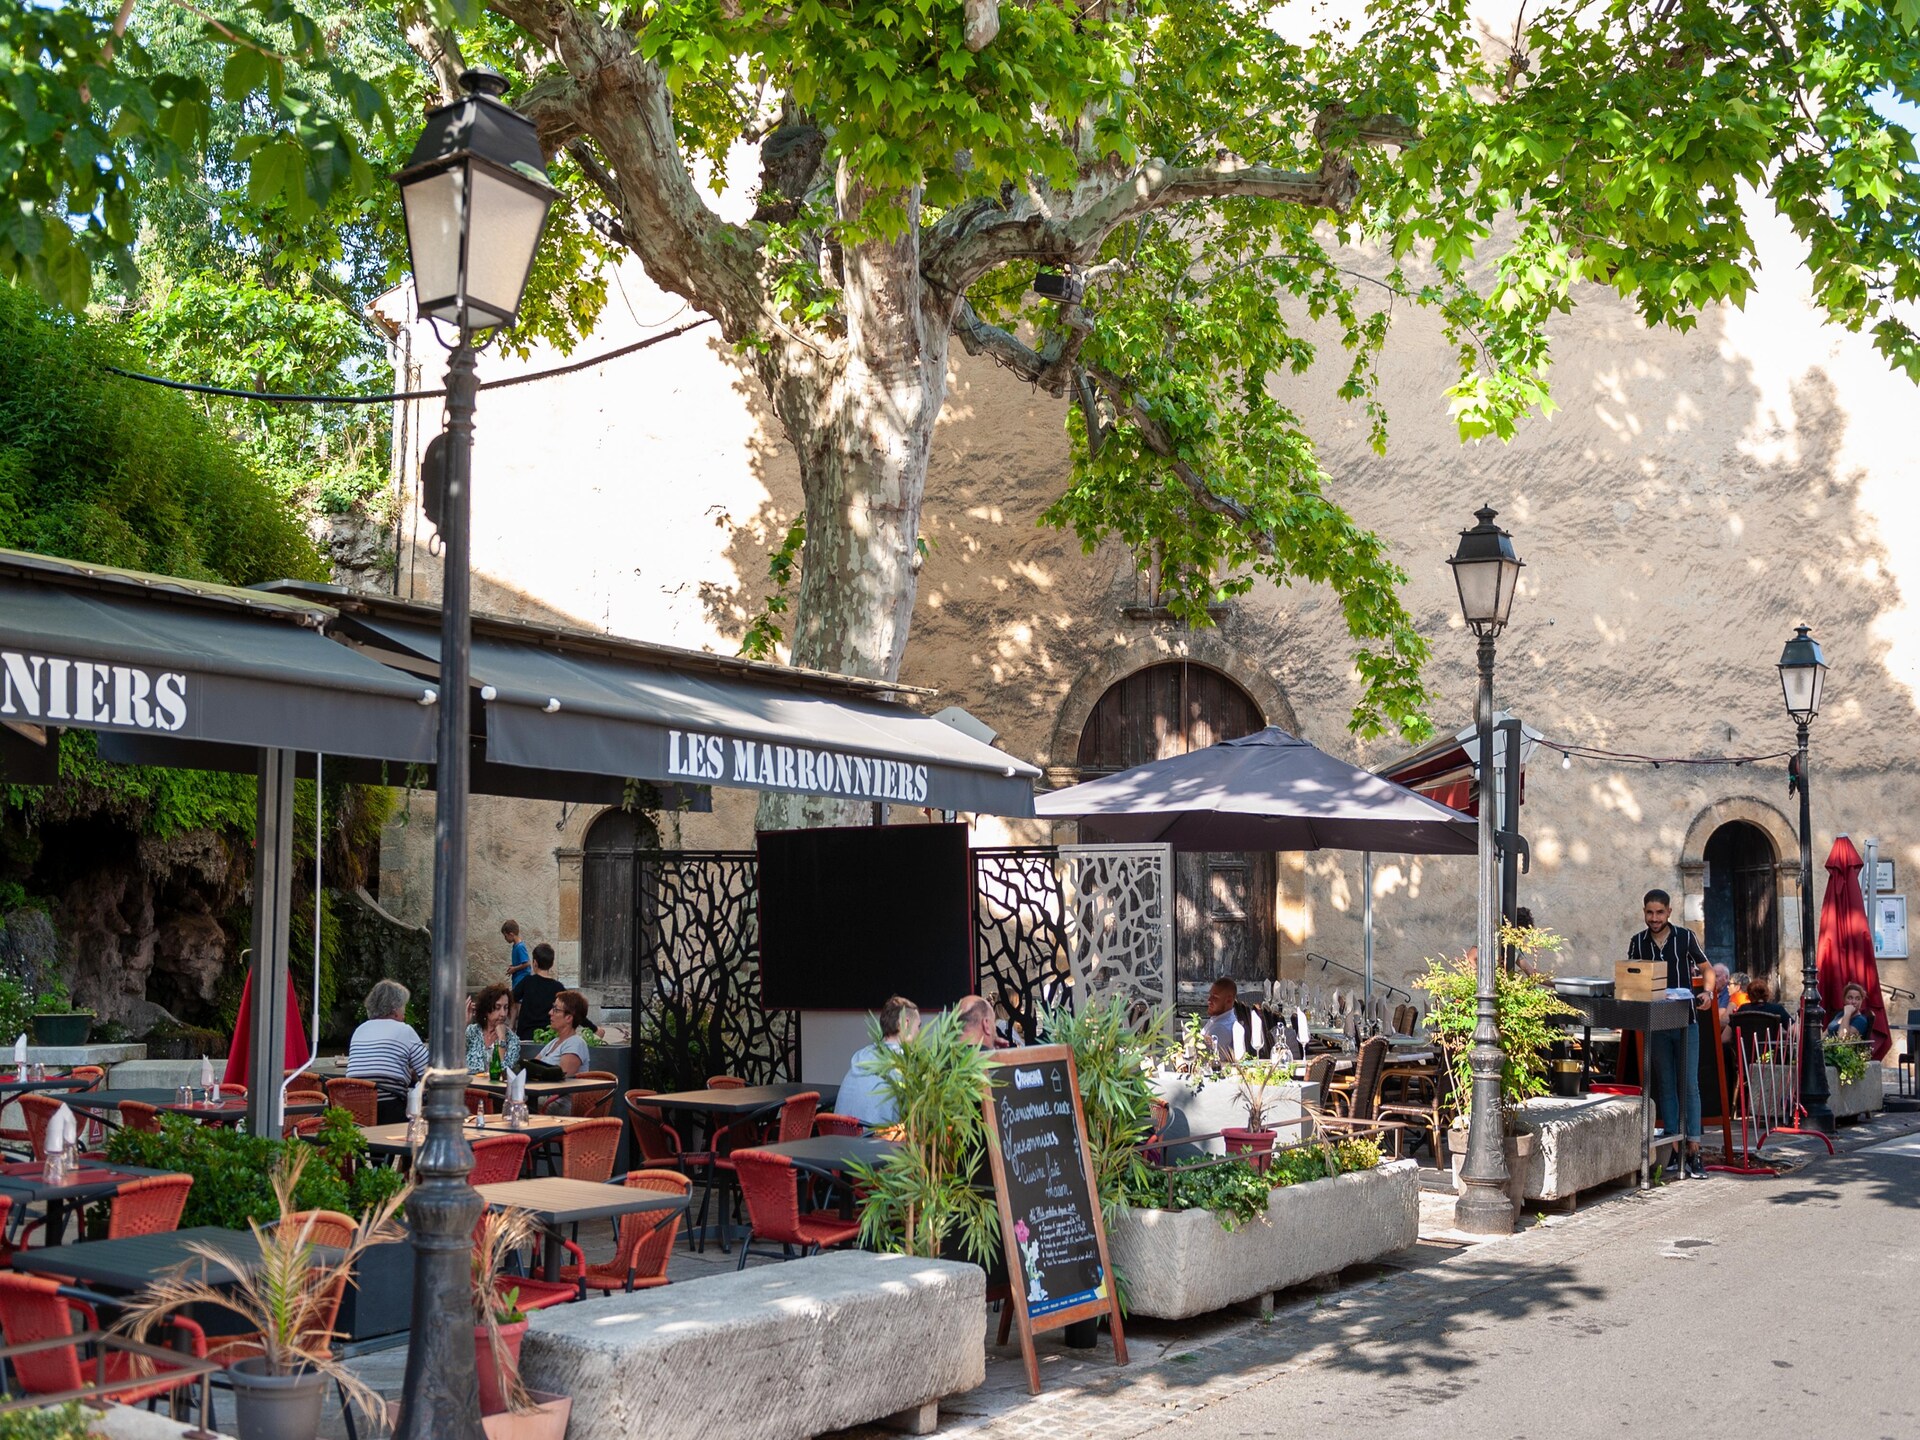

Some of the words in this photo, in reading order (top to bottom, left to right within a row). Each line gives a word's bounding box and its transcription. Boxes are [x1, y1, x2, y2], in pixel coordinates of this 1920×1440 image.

[1, 652, 187, 731] NIERS
[668, 730, 724, 779] LES
[732, 739, 928, 802] MARRONNIERS
